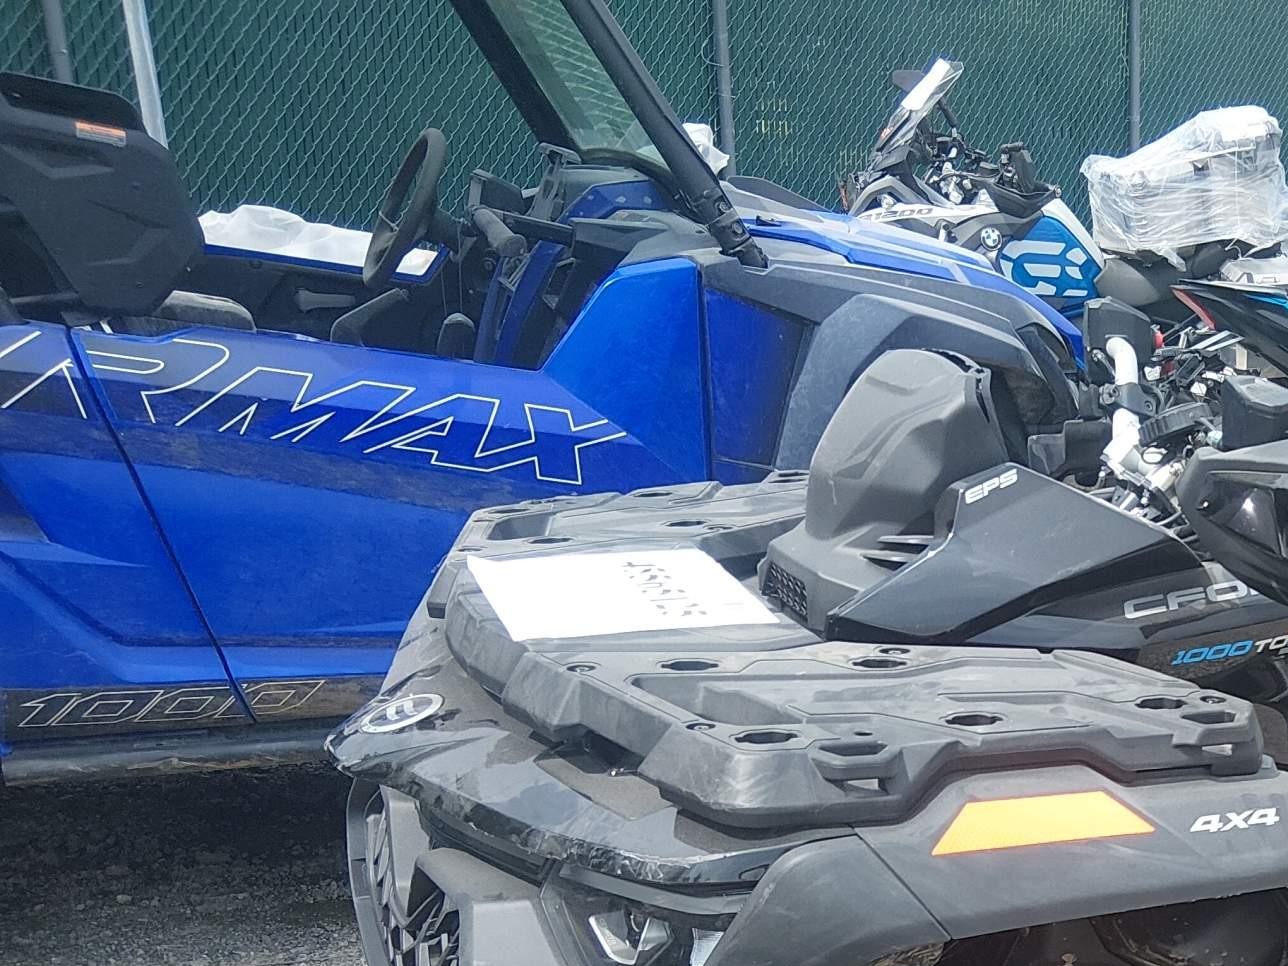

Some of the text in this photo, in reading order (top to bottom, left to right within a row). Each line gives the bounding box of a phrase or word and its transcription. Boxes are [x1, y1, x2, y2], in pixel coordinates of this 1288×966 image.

[965, 468, 1018, 504] EPS
[1124, 580, 1259, 619] CFO
[18, 680, 326, 727] 1000
